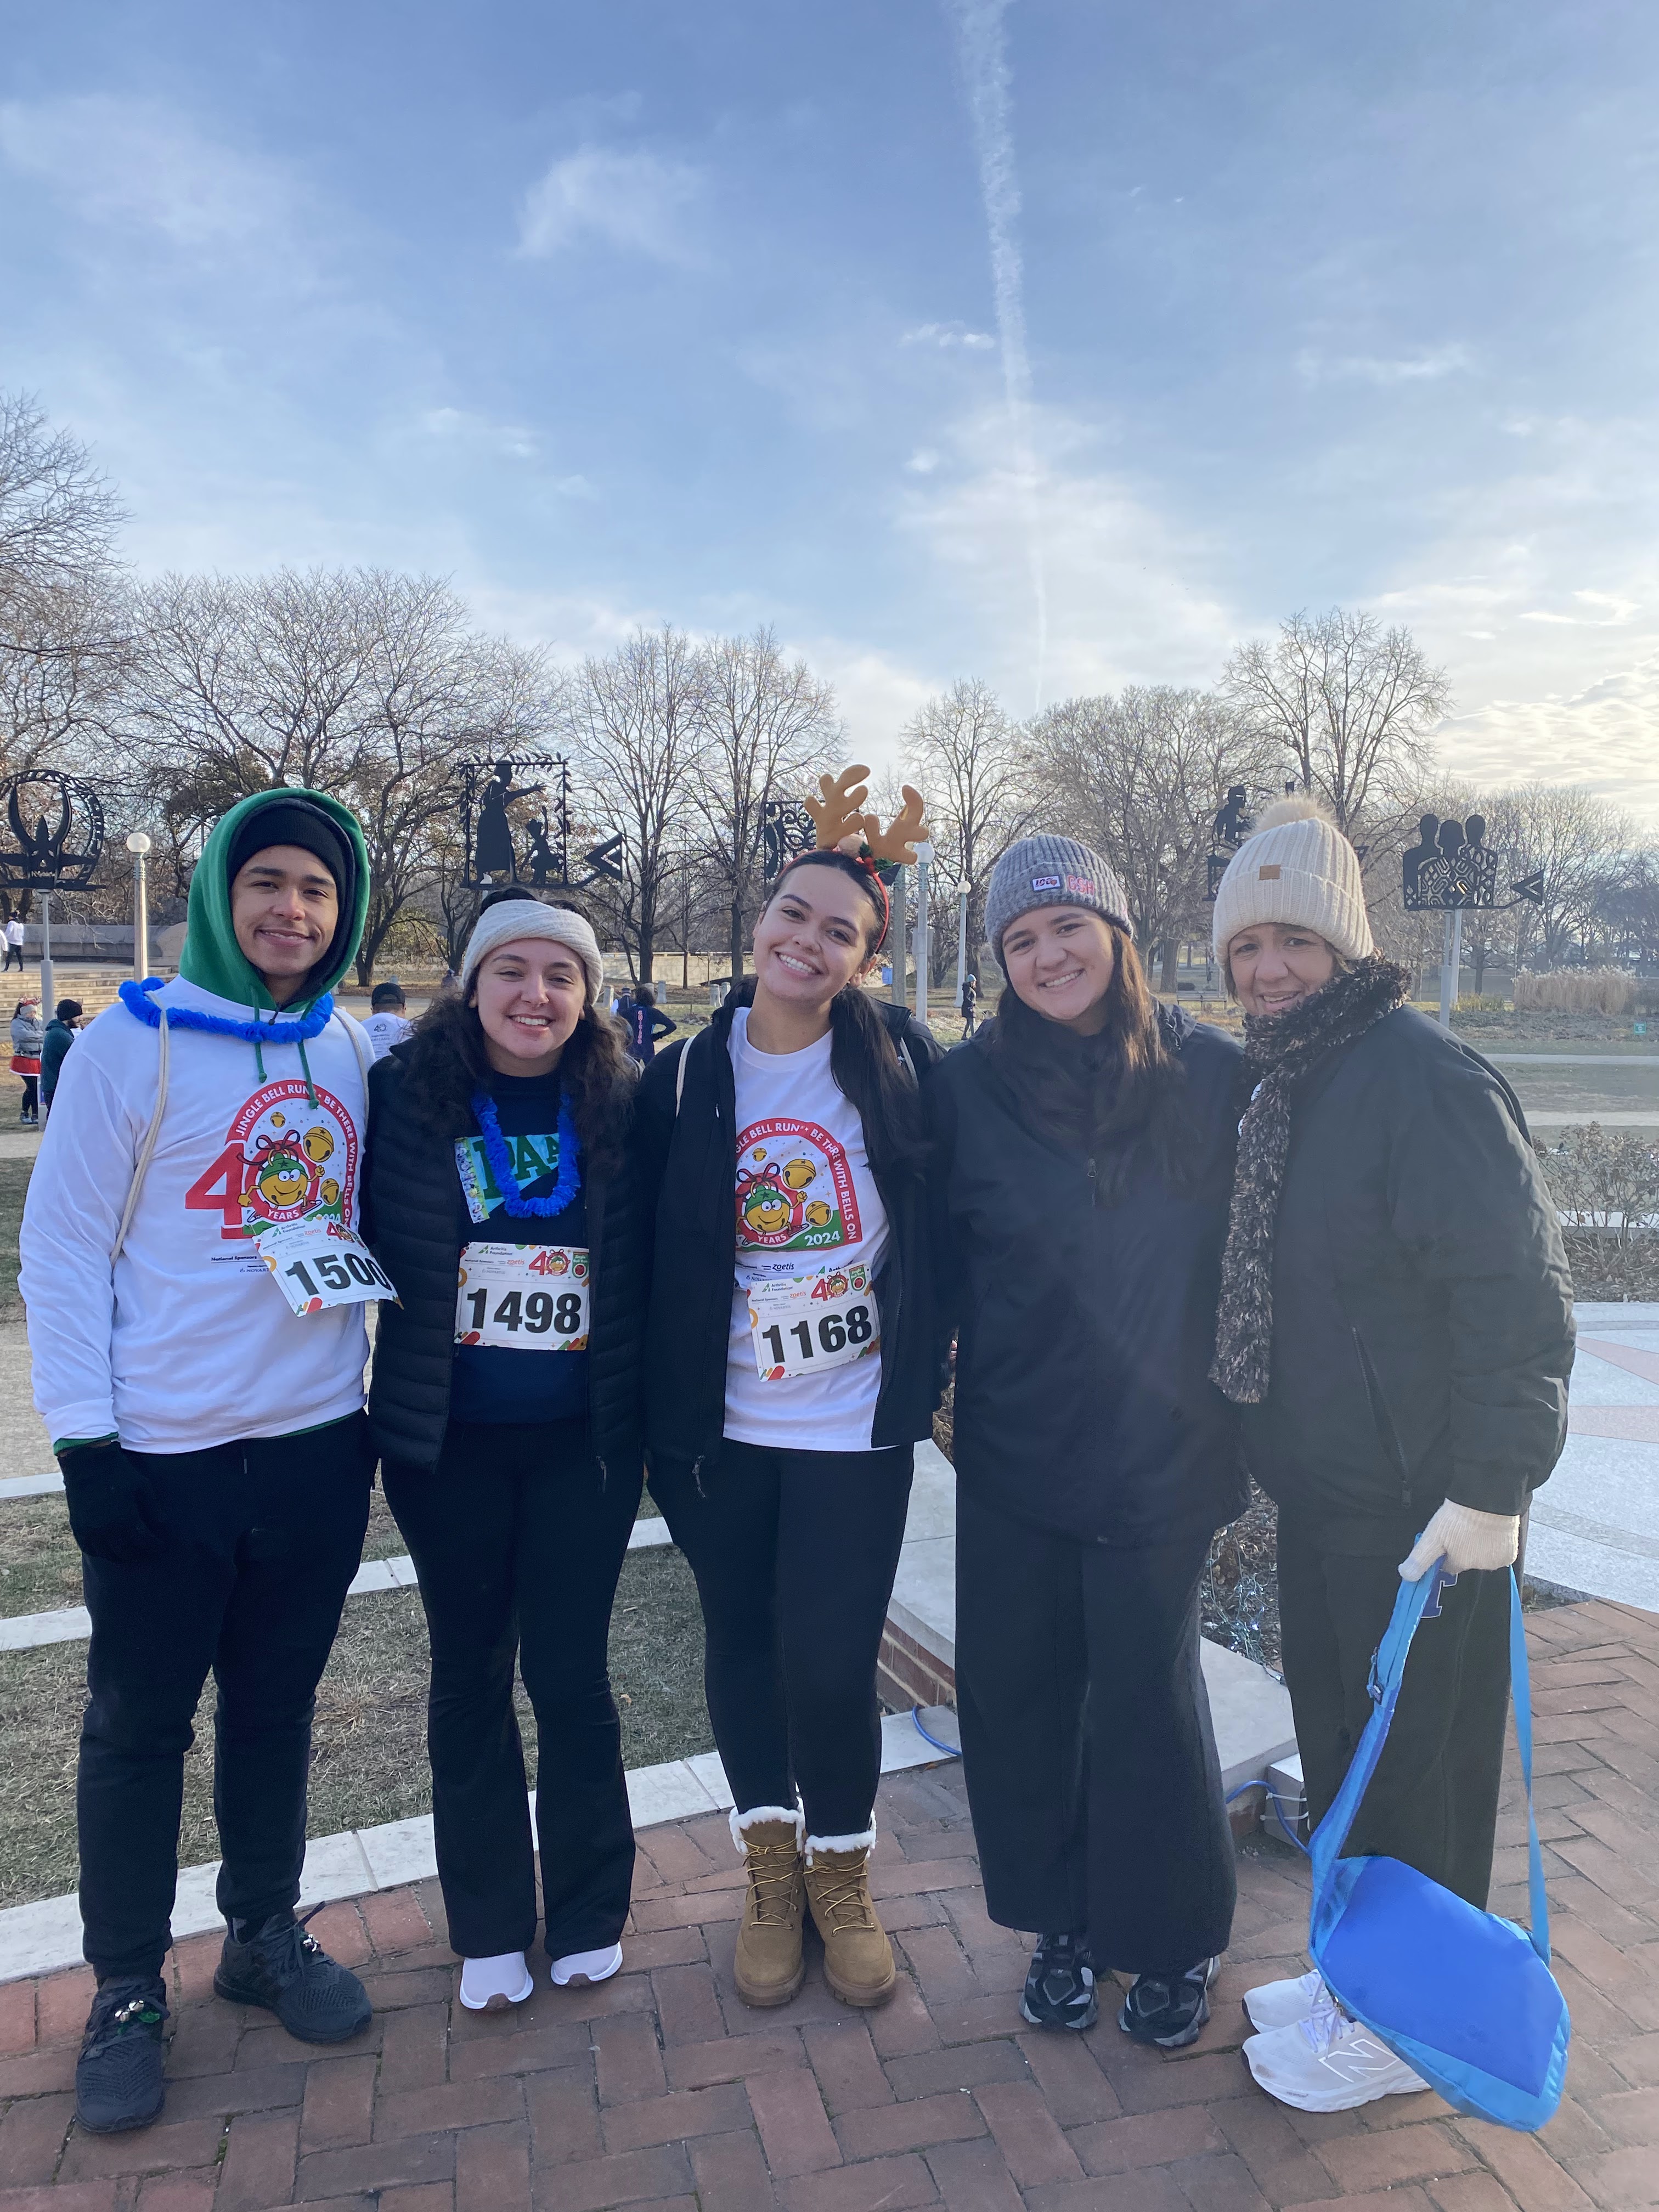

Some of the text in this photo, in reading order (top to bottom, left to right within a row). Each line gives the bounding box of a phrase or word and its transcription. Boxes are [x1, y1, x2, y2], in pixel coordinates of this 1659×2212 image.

[235, 1099, 263, 1137] JINGLE
[262, 1086, 285, 1103] BELL
[324, 1096, 336, 1109] BE
[336, 1106, 354, 1139] THERE
[749, 1124, 772, 1139] BELL
[775, 1122, 800, 1132] RUN
[810, 1128, 824, 1141] BE
[833, 1159, 848, 1188] WITH
[840, 1190, 854, 1221] BELLS
[268, 1209, 299, 1220] YEARS
[804, 1231, 840, 1246] 2024
[847, 1222, 857, 1240] ON
[758, 1234, 787, 1244] YEARS
[285, 1253, 392, 1296] 1500
[772, 1262, 794, 1272] zoetis
[790, 1291, 806, 1299] zoetis
[467, 1288, 582, 1334] 1498
[761, 1305, 872, 1363] 1168
